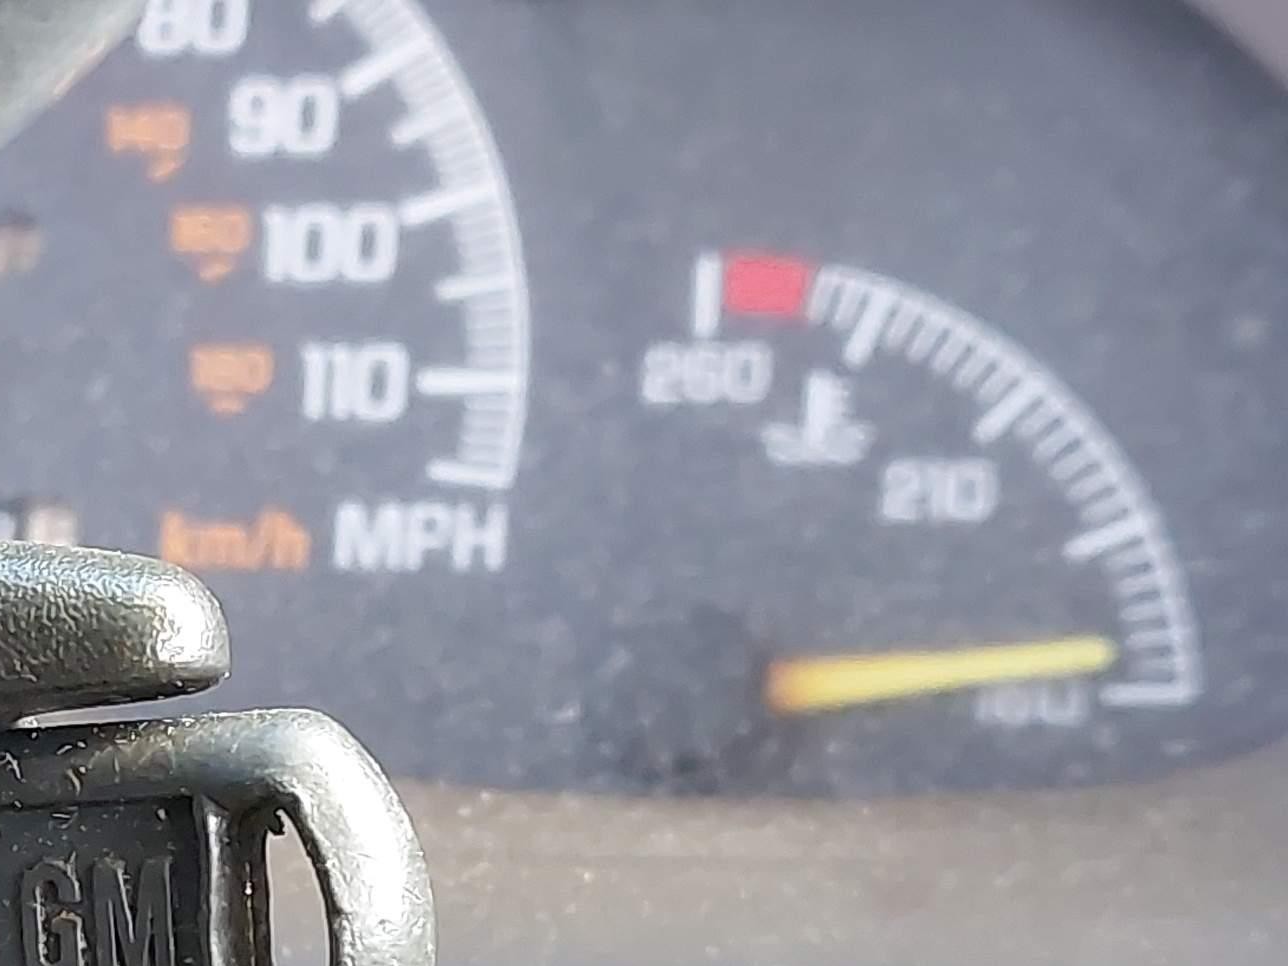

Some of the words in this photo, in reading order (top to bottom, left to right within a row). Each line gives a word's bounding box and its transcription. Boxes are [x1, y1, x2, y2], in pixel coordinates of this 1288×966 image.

[137, 0, 249, 56] 80
[228, 73, 338, 158] 90
[262, 204, 399, 284] 100
[300, 342, 409, 422] 110
[879, 457, 999, 524] 210
[159, 508, 311, 571] km/h
[331, 501, 509, 573] MPH
